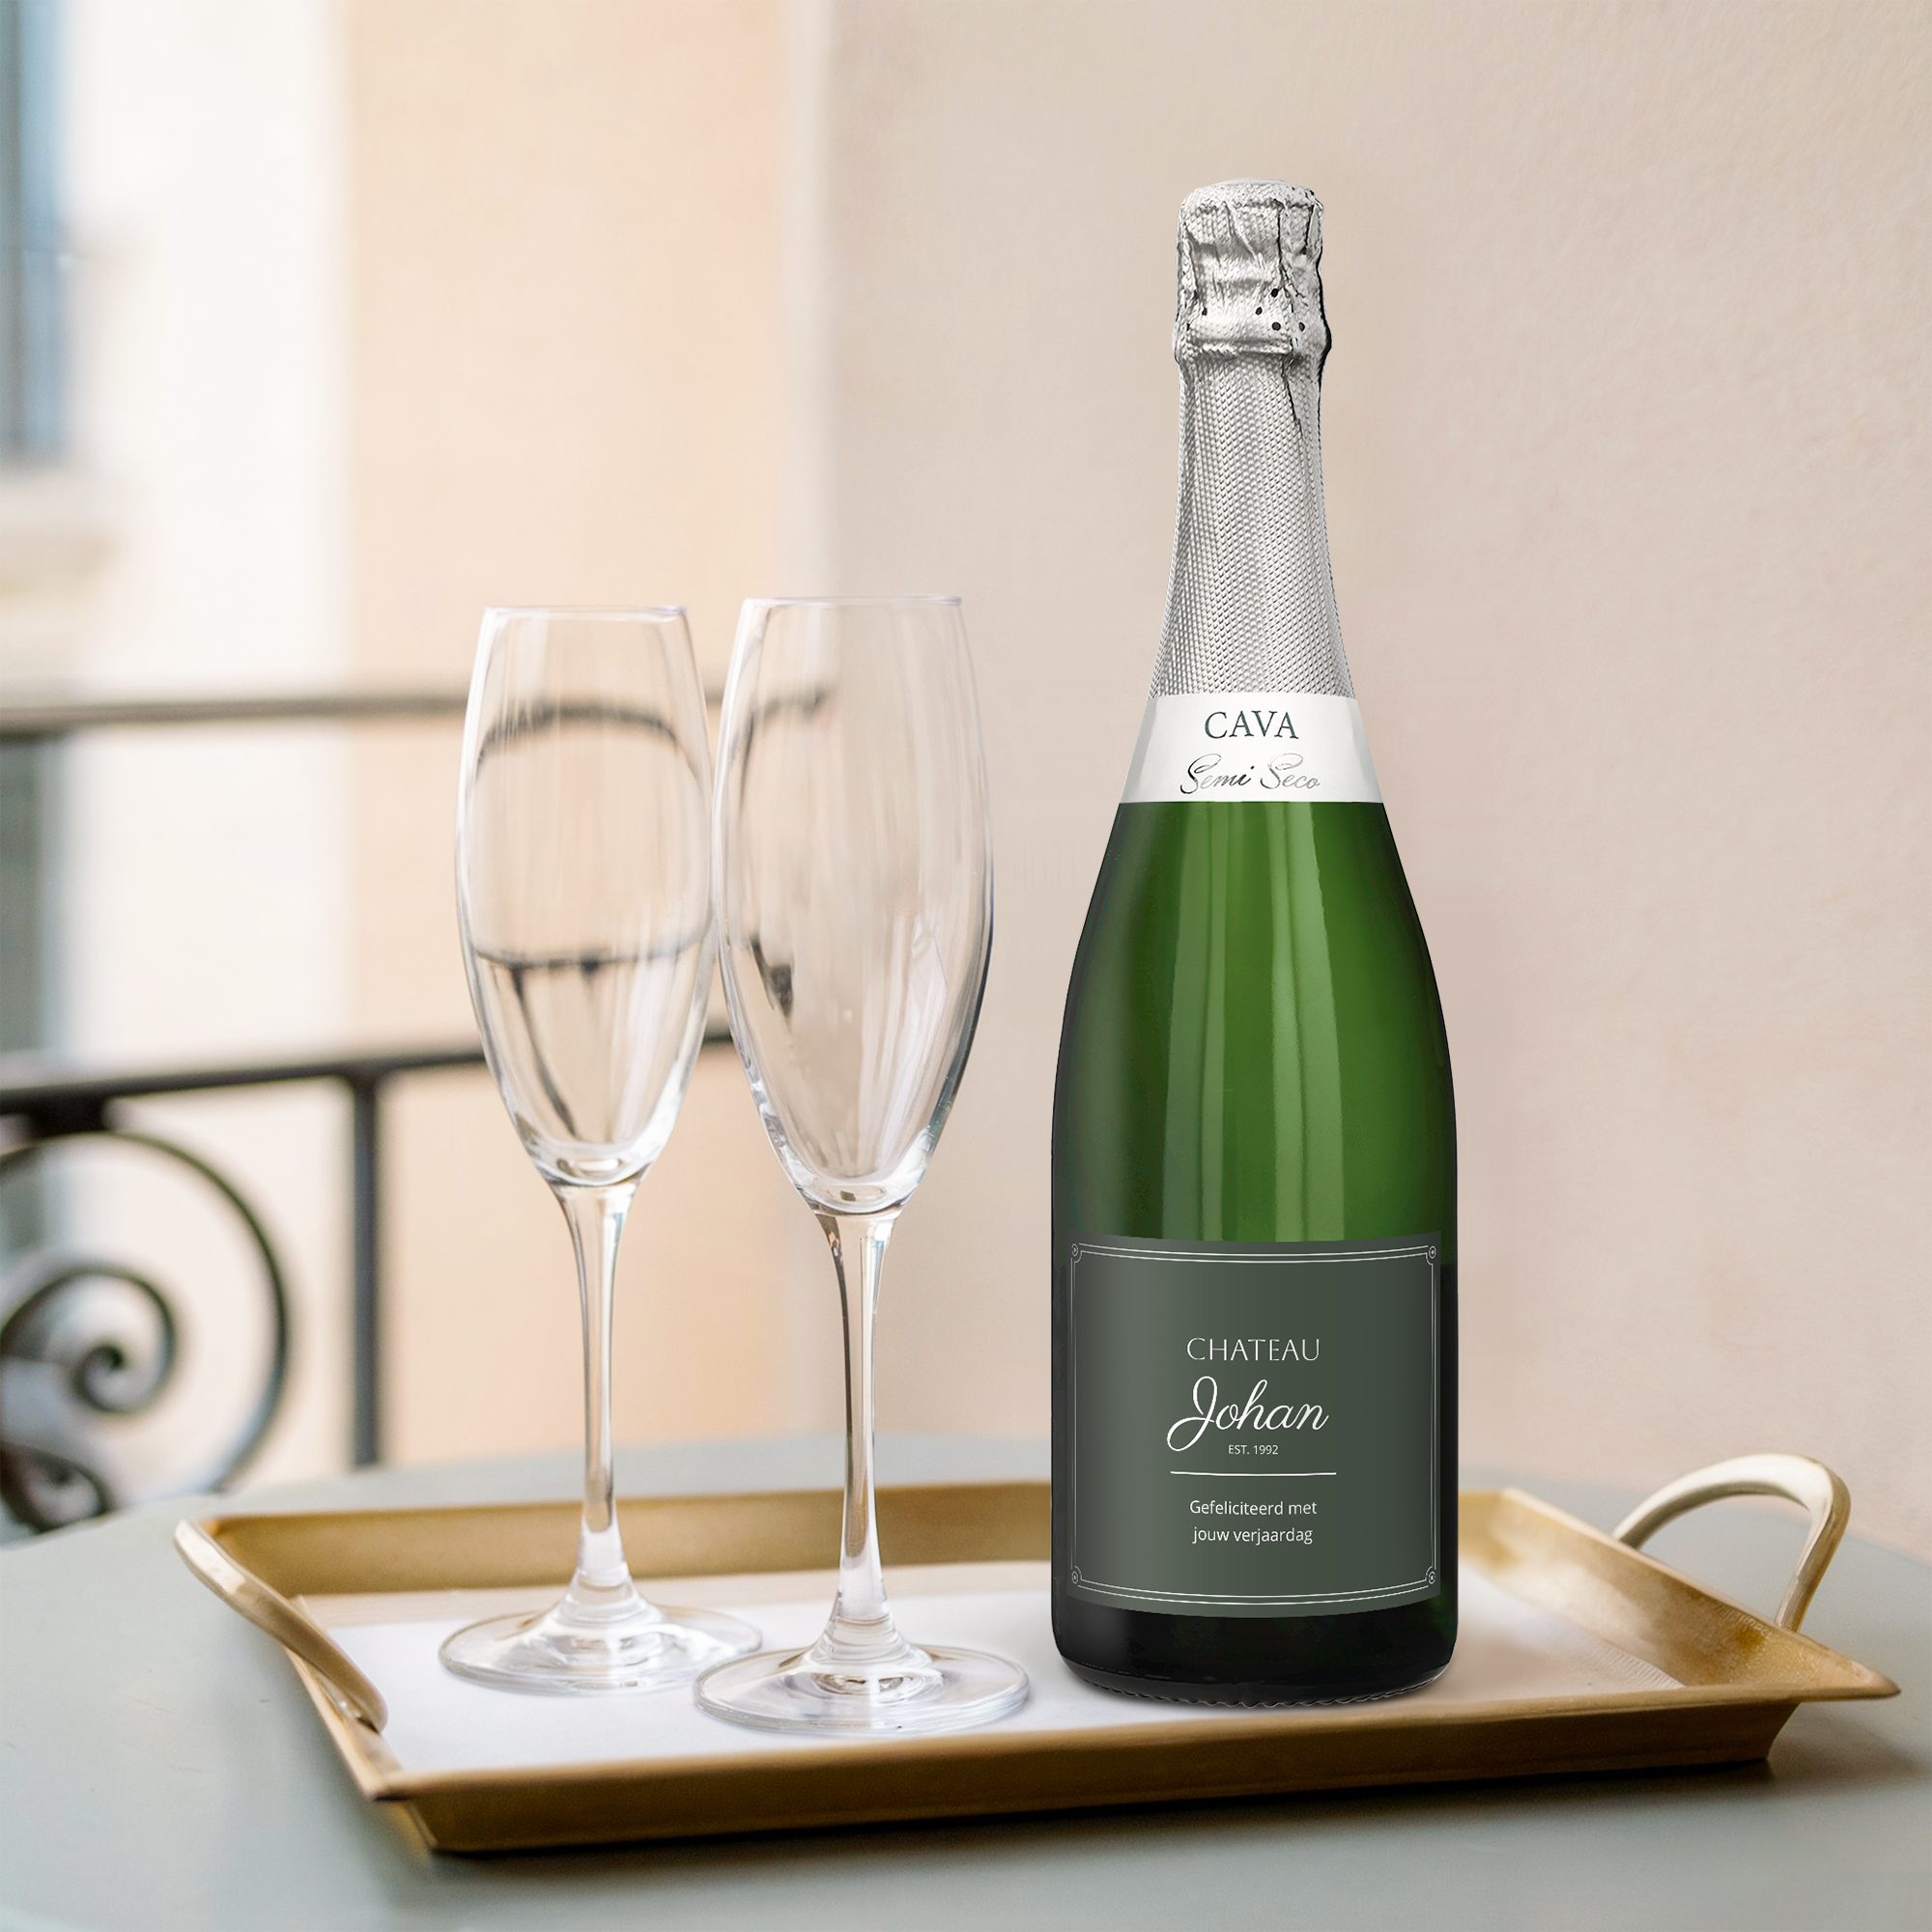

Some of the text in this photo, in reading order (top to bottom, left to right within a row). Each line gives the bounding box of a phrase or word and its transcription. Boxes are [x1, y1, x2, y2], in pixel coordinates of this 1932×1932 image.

[1204, 710, 1299, 740] CAVA
[1179, 753, 1321, 795] Semi Seco
[1186, 1337, 1321, 1361] CHATEAU
[1166, 1375, 1330, 1452] Johan
[1228, 1444, 1279, 1455] EST. 1992
[1189, 1499, 1318, 1516] Gefeliciteerd met
[1191, 1525, 1314, 1546] jouw verjaardag
